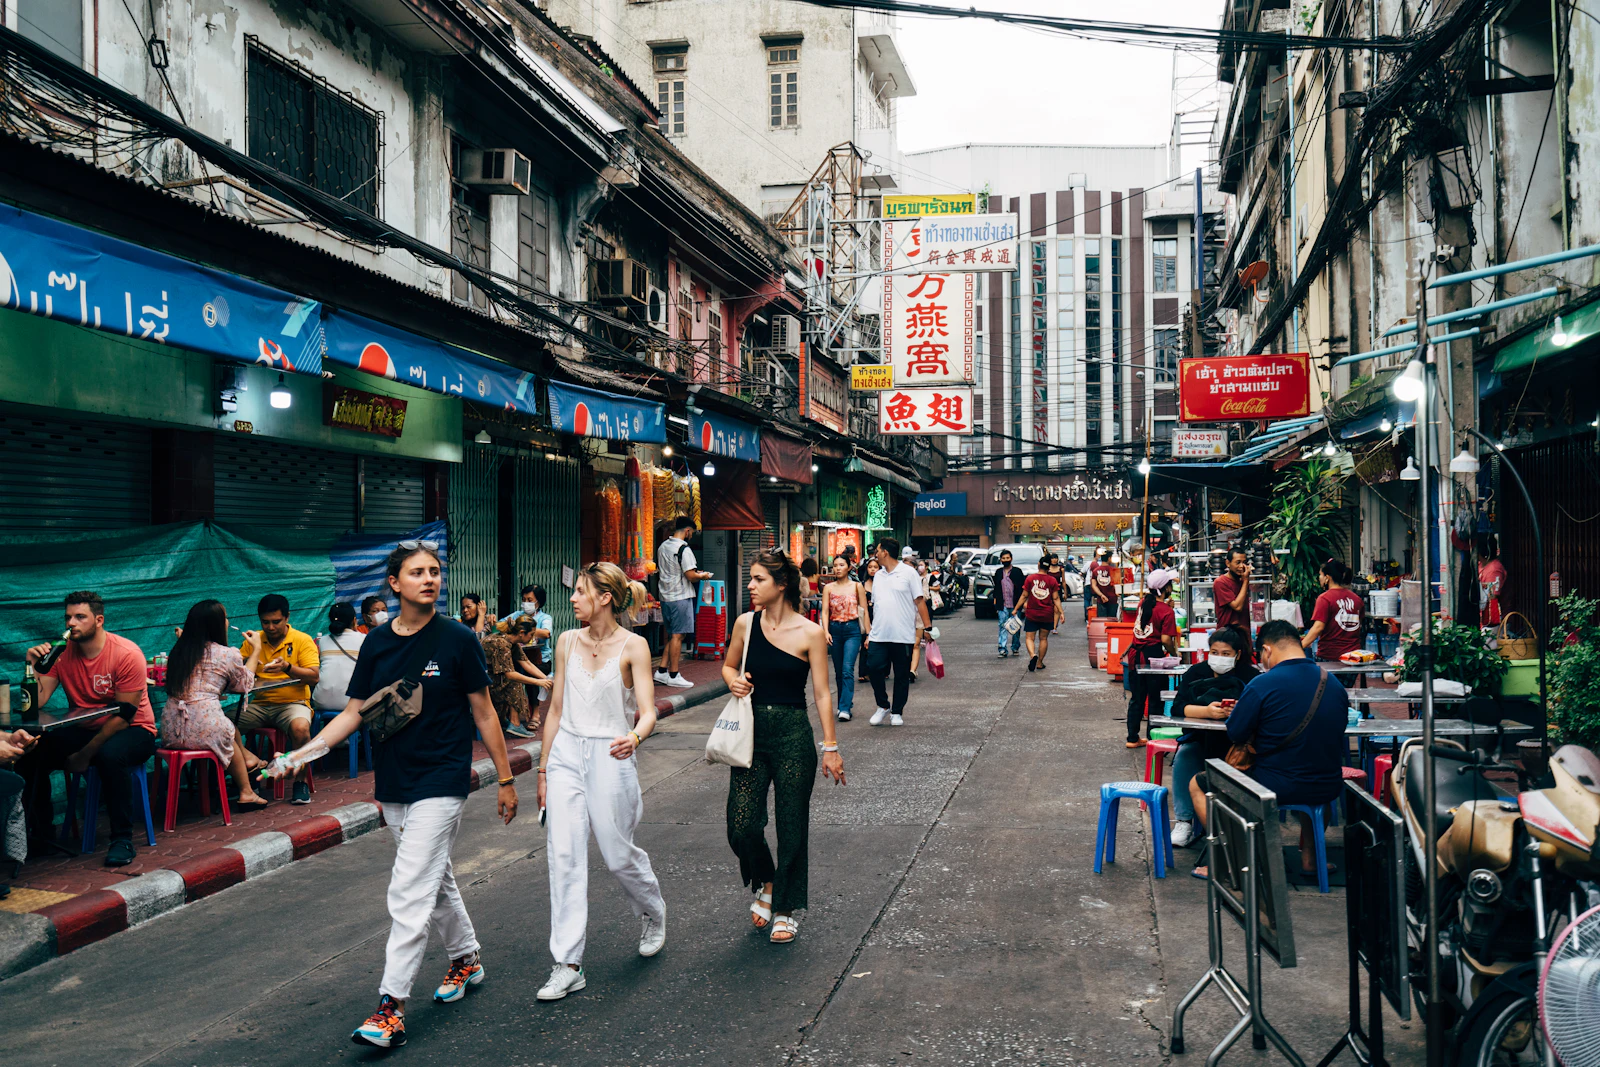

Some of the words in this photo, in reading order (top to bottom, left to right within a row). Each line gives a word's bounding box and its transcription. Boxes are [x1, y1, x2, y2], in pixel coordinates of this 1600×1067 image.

[886, 198, 973, 217] บูรพารังนก
[1223, 363, 1293, 378] ข้าวต้มปลา
[1209, 378, 1280, 394] ยำสามแซ่บ
[884, 392, 967, 431] 魚翅
[1220, 397, 1268, 414] Coca-Cola
